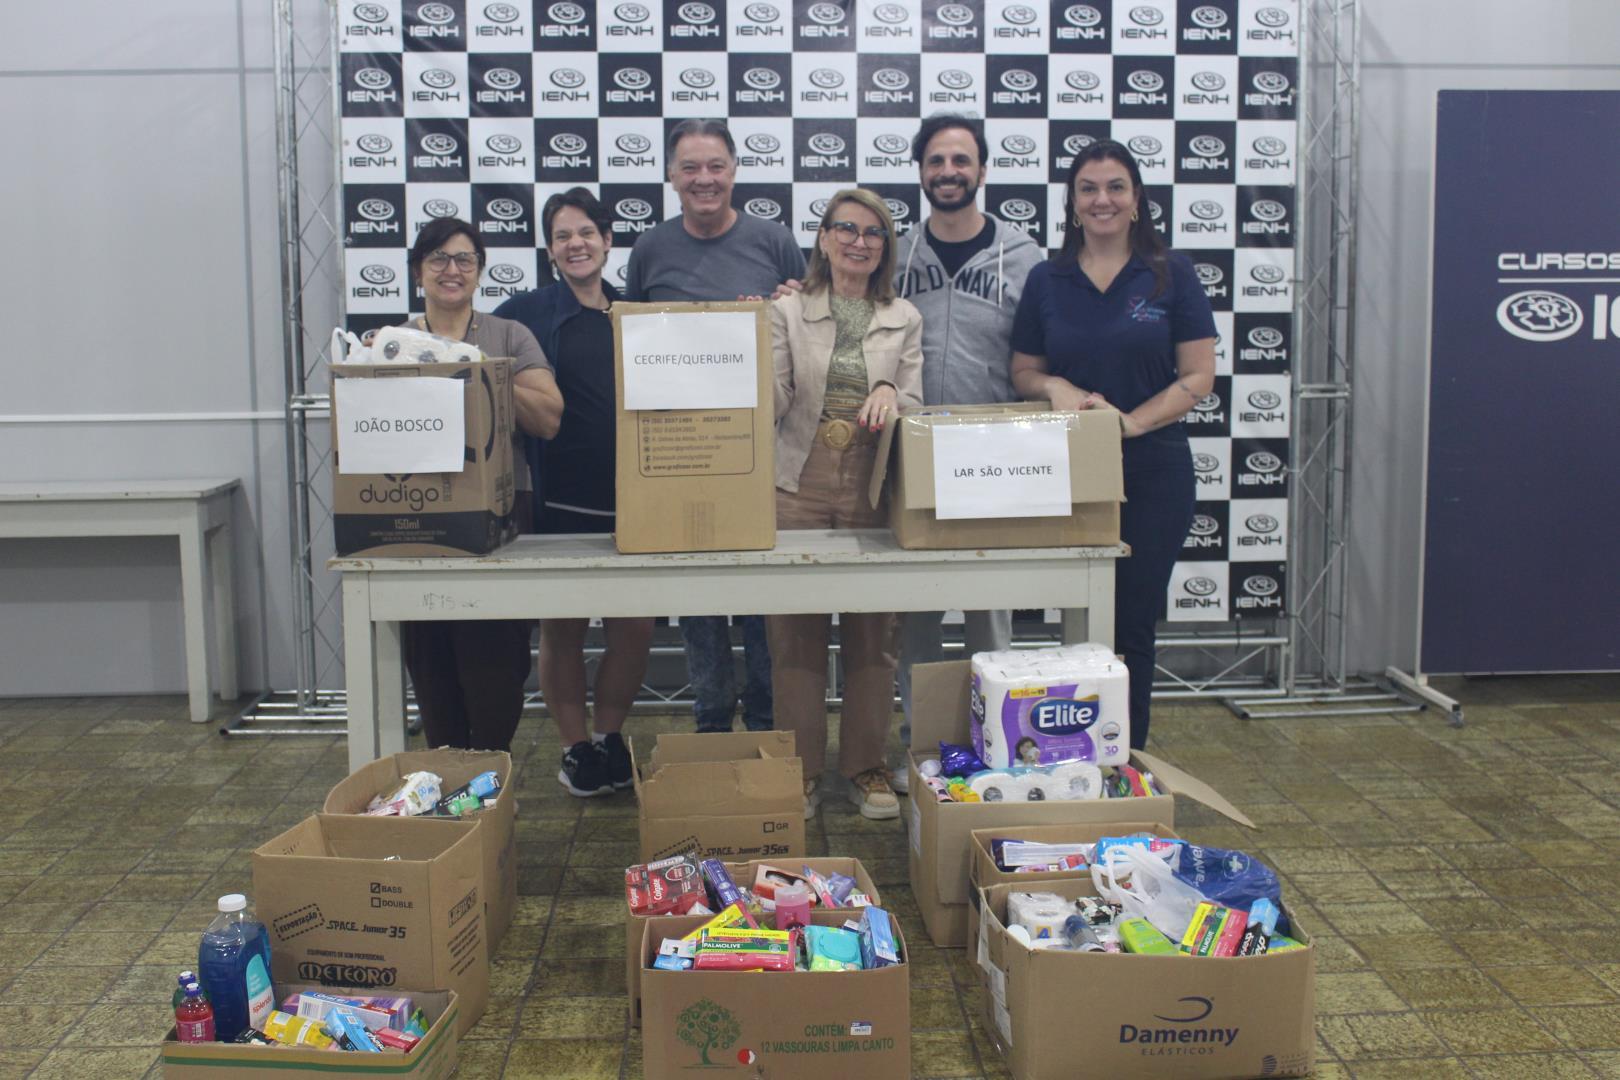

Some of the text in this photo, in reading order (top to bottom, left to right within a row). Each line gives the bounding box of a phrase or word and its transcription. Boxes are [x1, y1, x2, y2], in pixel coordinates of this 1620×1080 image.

[346, 25, 394, 37] IENH
[410, 25, 459, 37] IENH
[476, 25, 523, 37] IENH
[540, 24, 589, 36] IENH
[606, 25, 653, 37] IENH
[671, 24, 719, 36] IENH
[736, 25, 783, 37] IENH
[800, 25, 849, 37] IENH
[865, 25, 912, 37] IENH
[929, 26, 977, 38] IENH
[994, 27, 1040, 38] IENH
[1057, 27, 1105, 39] IENH
[1121, 28, 1167, 40] IENH
[1183, 28, 1231, 40] IENH
[1247, 29, 1292, 41] IENH
[347, 90, 396, 102] IENH
[412, 90, 460, 102] IENH
[477, 90, 525, 102] IENH
[542, 90, 589, 102] IENH
[606, 90, 655, 102] IENH
[672, 90, 719, 102] IENH
[736, 90, 784, 102] IENH
[801, 90, 848, 102] IENH
[865, 90, 913, 102] IENH
[930, 91, 976, 103] IENH
[993, 91, 1041, 103] IENH
[1057, 92, 1103, 104] IENH
[1120, 92, 1167, 104] IENH
[1183, 93, 1229, 105] IENH
[1245, 94, 1291, 106] IENH
[349, 156, 396, 168] IENH
[413, 155, 461, 167] IENH
[478, 156, 525, 167] IENH
[543, 155, 591, 167] IENH
[608, 156, 655, 167] IENH
[801, 155, 849, 167] IENH
[865, 156, 913, 168] IENH
[993, 156, 1040, 168] IENH
[1056, 157, 1075, 168] IE
[1138, 158, 1166, 169] NH
[1182, 157, 1228, 169] IENH
[1245, 158, 1290, 170] IENH
[351, 221, 398, 233] IENH
[479, 220, 527, 232] IENH
[612, 221, 656, 232] ENH
[801, 221, 820, 232] IE
[1181, 221, 1227, 233] IENH
[1243, 221, 1289, 233] IENH
[898, 264, 944, 300] OLD
[353, 286, 399, 298] IENH
[1242, 285, 1288, 297] IENH
[634, 354, 744, 366] CECRIFE/QUERUBIM
[1240, 348, 1286, 360] IENH
[1180, 411, 1224, 423] ENH
[1240, 411, 1284, 423] IENH
[354, 417, 444, 433] JOÃO BOSCO
[954, 465, 1053, 478] LAR SÃO VICENTE
[1196, 474, 1223, 484] NH
[1238, 473, 1284, 485] IENH
[359, 484, 439, 512] dudigo
[1183, 535, 1222, 547] ENH
[1237, 535, 1282, 547] IENH
[1176, 597, 1220, 609] IENH
[1236, 596, 1281, 608] IENH
[1039, 704, 1093, 728] Elite
[654, 878, 663, 901] Colgate
[382, 899, 413, 909] DOUBLE
[326, 920, 359, 932] SPACE
[388, 925, 407, 939] 35
[299, 962, 397, 986] METEORO
[804, 1022, 848, 1037] CONTÉM:
[1119, 1025, 1239, 1048] Damenny
[761, 1038, 894, 1054] 12 VASSOURAS LIMPA CANTO
[1141, 1044, 1215, 1056] ELÁSTICOS
